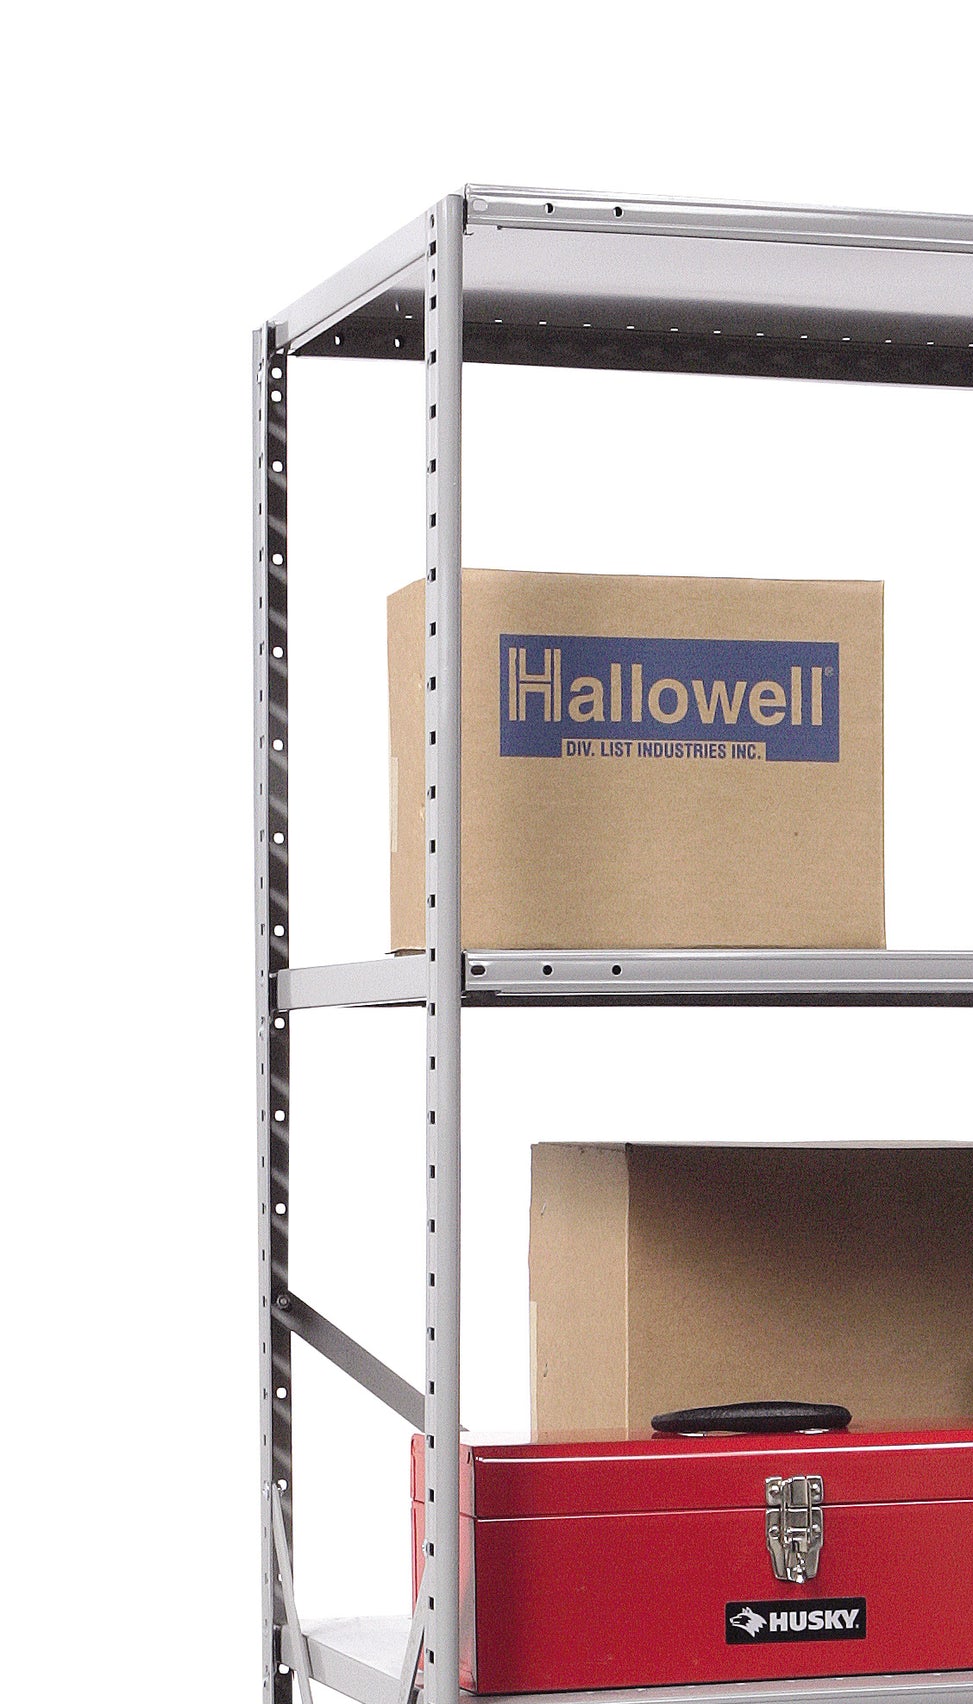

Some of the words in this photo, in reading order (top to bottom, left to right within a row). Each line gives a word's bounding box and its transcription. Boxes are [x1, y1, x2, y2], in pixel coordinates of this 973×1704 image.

[508, 647, 824, 726] Hallowell
[566, 740, 595, 757] DIV.
[601, 741, 632, 757] LIST
[638, 741, 727, 759] INDUSTRIES
[731, 744, 762, 760] INC.
